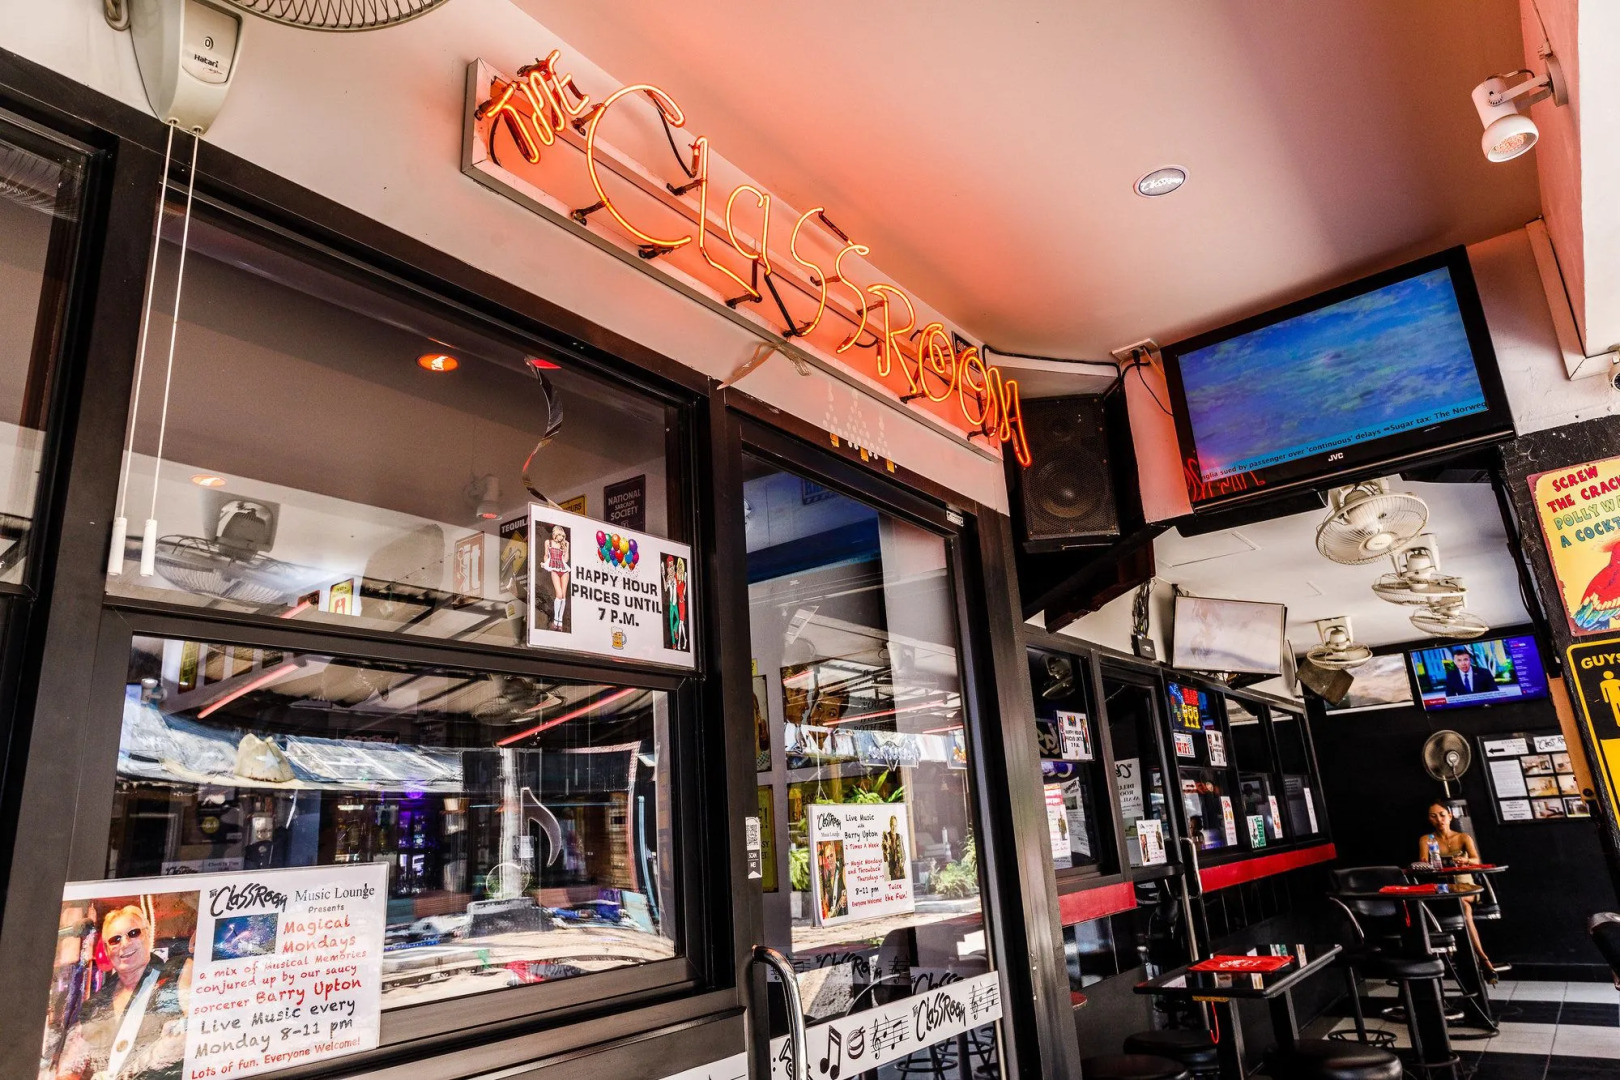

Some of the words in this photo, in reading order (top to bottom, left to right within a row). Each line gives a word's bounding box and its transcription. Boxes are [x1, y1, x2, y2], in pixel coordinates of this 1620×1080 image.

[194, 54, 219, 68] Hatari
[1220, 466, 1237, 476] sued
[1238, 464, 1248, 472] by
[1249, 454, 1286, 470] passenger
[1288, 450, 1305, 458] over
[1355, 429, 1382, 440] delays
[1434, 411, 1450, 420] The
[1328, 452, 1344, 462] JVC
[1552, 465, 1598, 493] SCREW
[608, 489, 641, 505] NATIONAL
[1546, 493, 1576, 514] THE
[610, 505, 638, 520] SOCIETY
[1553, 503, 1600, 530] POLLY
[1560, 534, 1572, 548] A
[576, 566, 618, 587] HAPPY
[623, 577, 658, 596] HOUR
[571, 583, 620, 606] PRICES
[625, 596, 662, 614] UNTIL
[598, 607, 606, 620] 7
[611, 609, 639, 627] P.M.
[845, 814, 858, 822] Live
[860, 813, 874, 821] Music
[844, 831, 860, 842] Barry
[862, 830, 878, 841] Upton
[295, 888, 331, 902] Music
[335, 883, 375, 900] Lounge
[855, 887, 868, 895] 8-11
[871, 887, 879, 897] pm
[308, 903, 345, 913] Presents
[283, 915, 351, 936] Magical
[282, 935, 356, 954] Mondays
[214, 967, 237, 977] mix
[244, 961, 259, 974] of
[315, 951, 367, 964] Memories
[196, 976, 256, 994] conjured
[262, 976, 277, 988] up
[282, 971, 295, 985] by
[301, 970, 320, 978] our
[326, 965, 357, 976] saucy
[194, 999, 250, 1015] sorcerer
[256, 988, 305, 1005] Barry
[314, 978, 362, 1001] Upton
[201, 1017, 241, 1035] Live
[251, 1007, 301, 1027] Music
[310, 999, 356, 1016] every
[194, 1033, 271, 1059] Monday
[281, 1022, 320, 1040] 8-11
[330, 1018, 353, 1039] pm
[191, 1067, 216, 1080] Lots
[221, 1062, 233, 1073] of
[238, 1057, 259, 1071] fun.
[264, 1048, 311, 1065] Everyone
[314, 1037, 360, 1053] Welcome!
